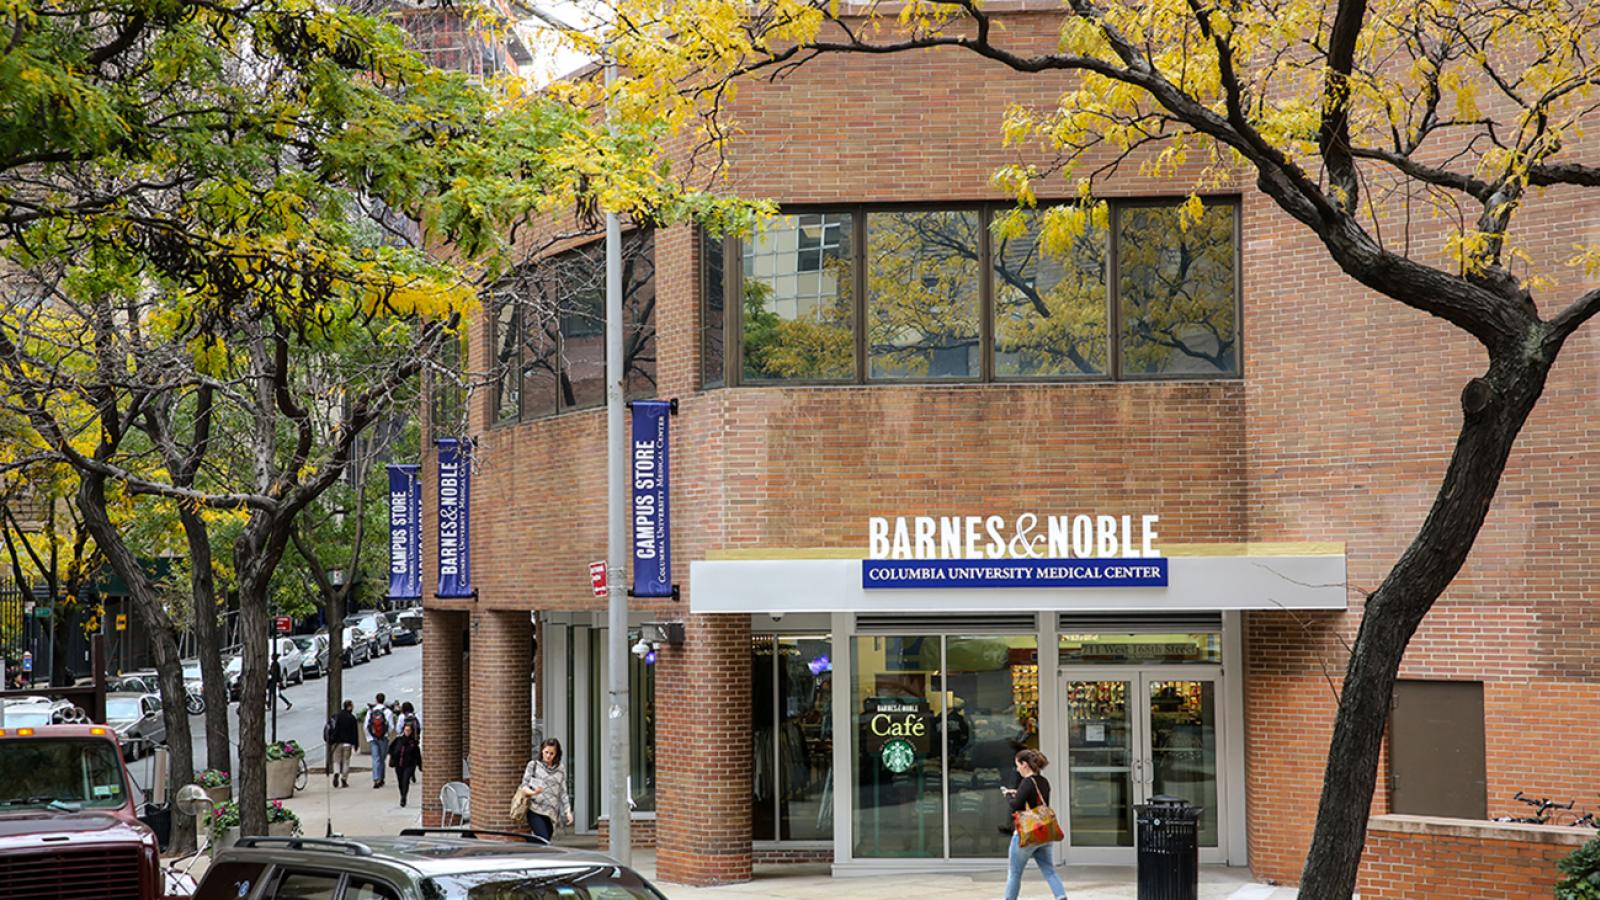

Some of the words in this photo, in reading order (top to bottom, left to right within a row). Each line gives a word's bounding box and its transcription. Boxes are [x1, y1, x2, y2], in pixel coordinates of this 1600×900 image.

[656, 416, 664, 449] CENTER
[635, 440, 655, 489] STORE
[656, 450, 664, 487] MEDICAL
[392, 491, 407, 526] STORE
[440, 463, 458, 575] BARNES&NOBLE
[635, 495, 655, 559] CAMPUS
[656, 491, 664, 539] UNIVERSITY
[392, 529, 407, 574] CAMPUS
[868, 512, 1161, 560] BARNES&NOBLE
[658, 540, 666, 583] COLUMBIA
[868, 567, 946, 580] COLUMBIA
[947, 566, 1033, 580] UNIVERSITY
[1036, 566, 1102, 579] MEDICAL
[1104, 565, 1161, 578] CENTER
[1104, 643, 1128, 654] West
[1165, 643, 1196, 654] Street
[871, 713, 925, 737] Café
